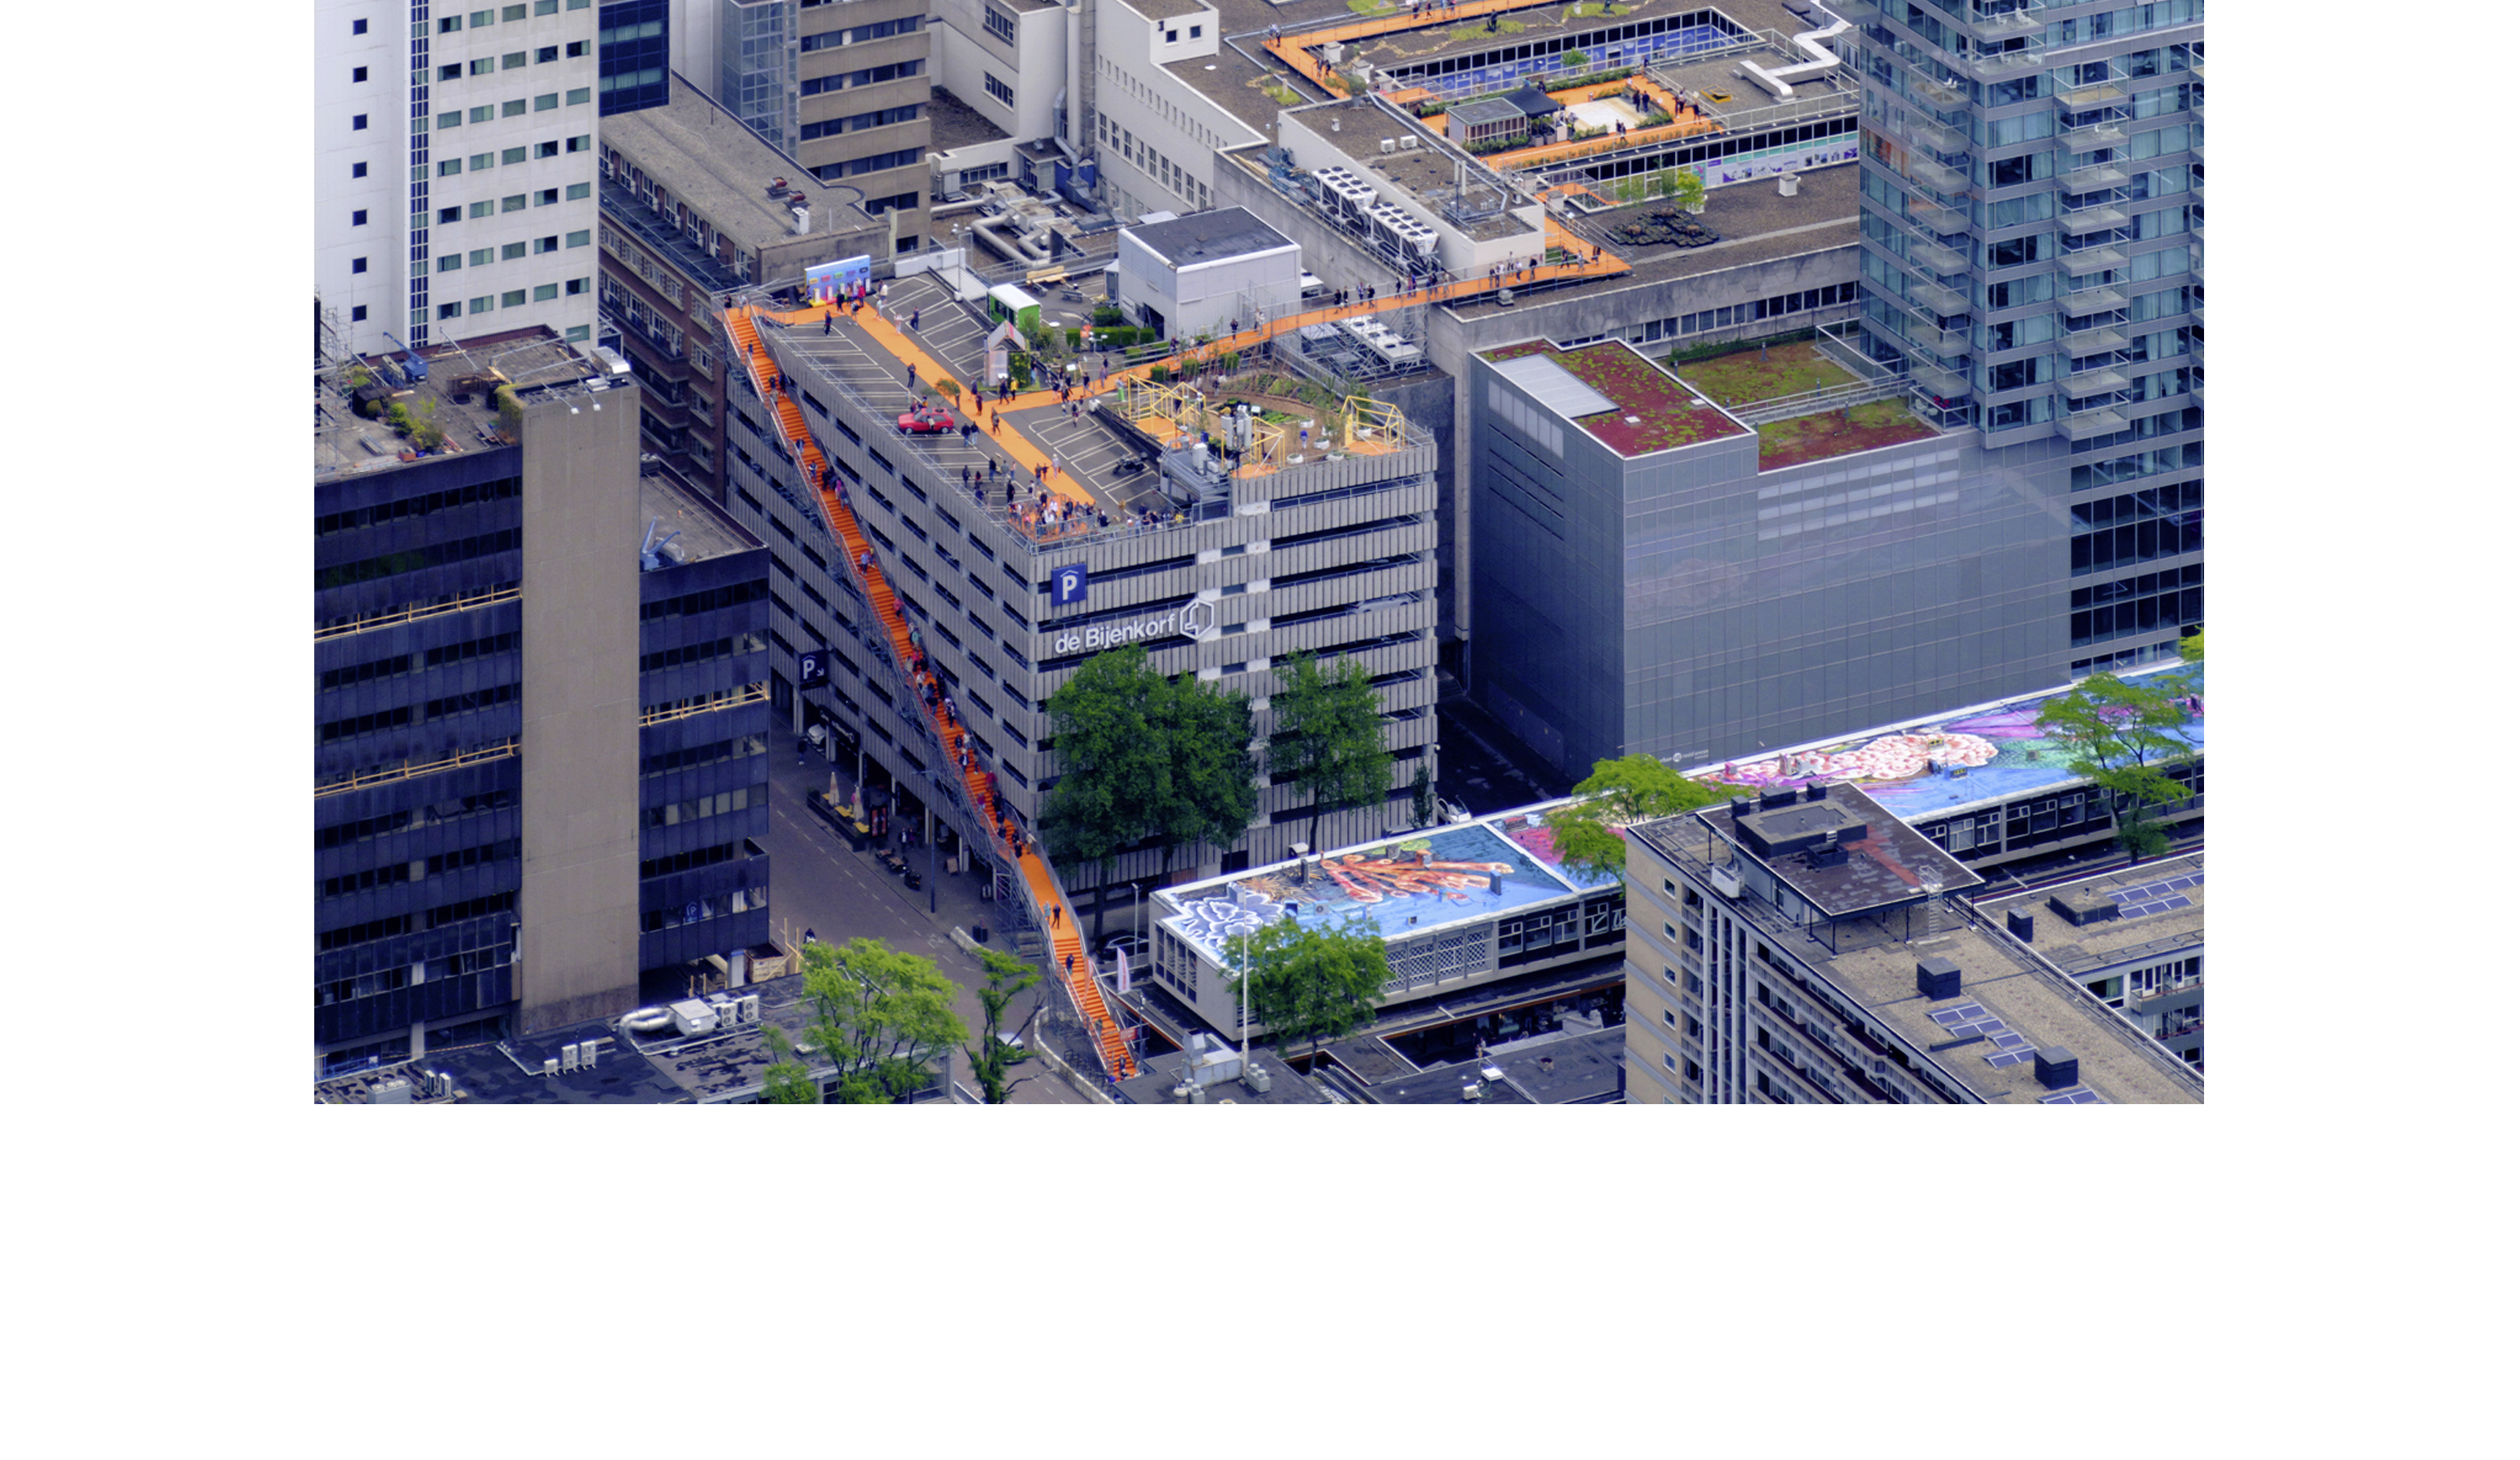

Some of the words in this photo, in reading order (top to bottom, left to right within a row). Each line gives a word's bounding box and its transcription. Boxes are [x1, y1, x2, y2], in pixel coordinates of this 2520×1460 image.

[1063, 575, 1077, 600] P
[1055, 633, 1080, 653] de
[1085, 612, 1175, 649] Bijenkorf
[803, 659, 815, 679] P
